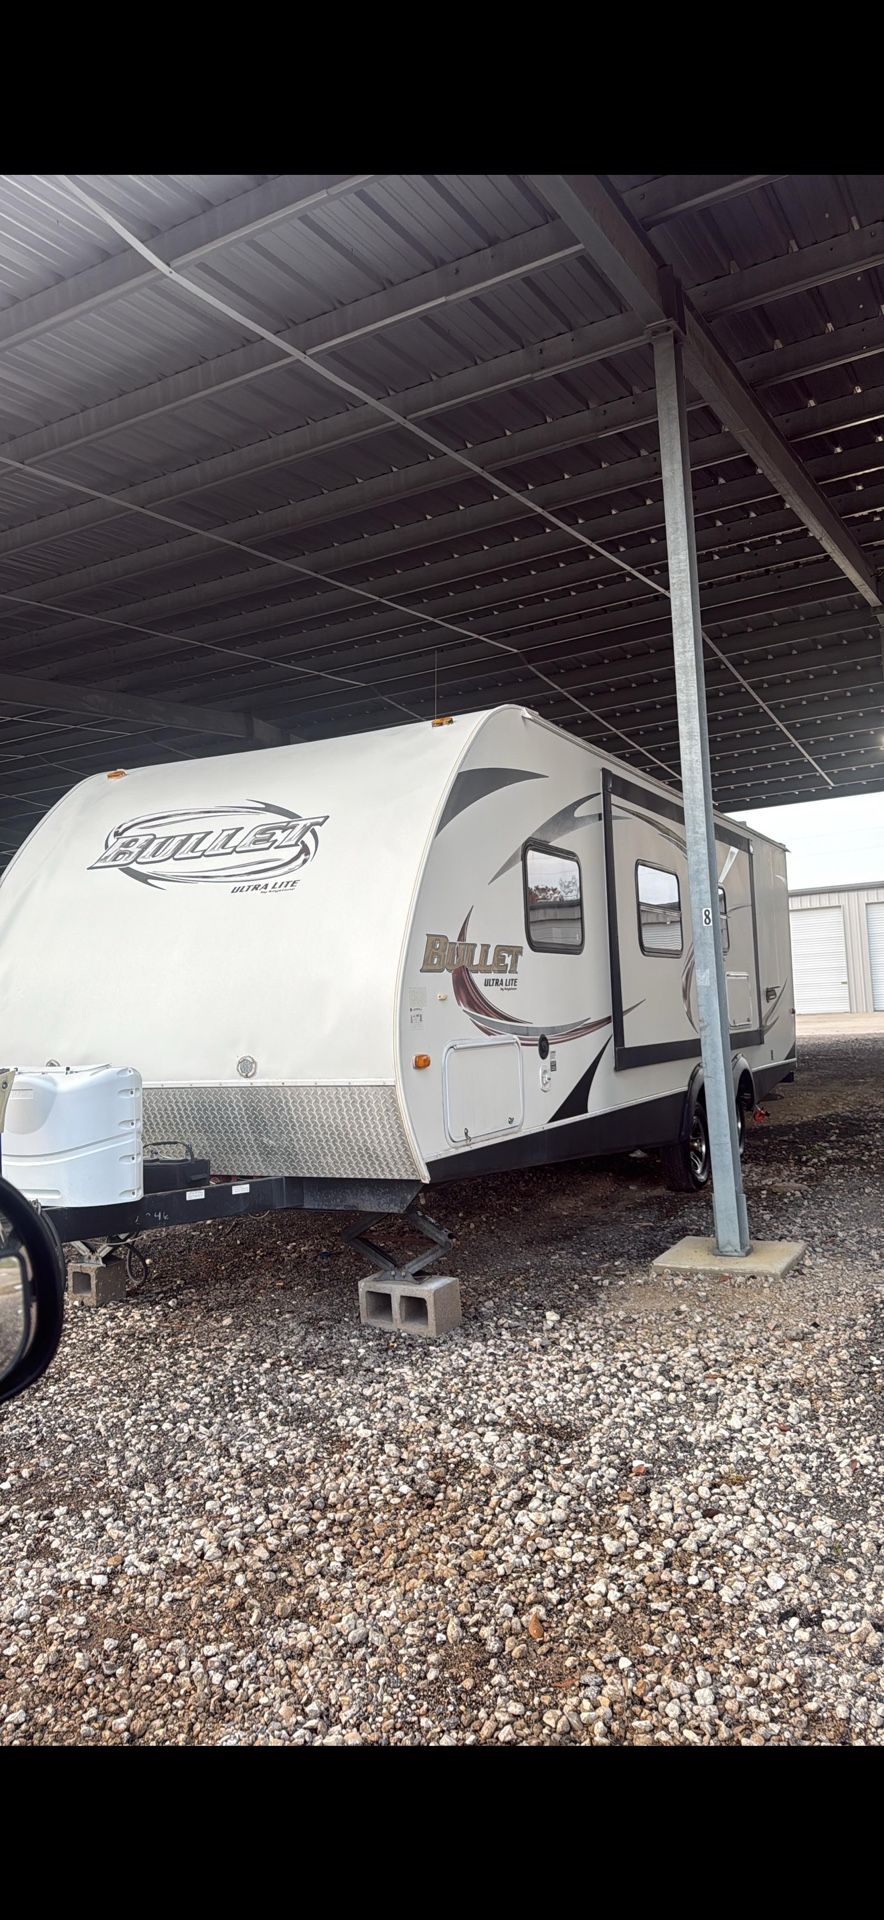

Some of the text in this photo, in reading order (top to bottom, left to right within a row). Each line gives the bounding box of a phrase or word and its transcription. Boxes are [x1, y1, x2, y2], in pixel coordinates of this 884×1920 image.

[86, 815, 330, 870] BULLET
[231, 883, 269, 894] ULTRA
[271, 879, 301, 889] LITE
[703, 908, 712, 926] 8
[420, 933, 524, 974] BULLET
[484, 978, 518, 987] ULTRA LITE
